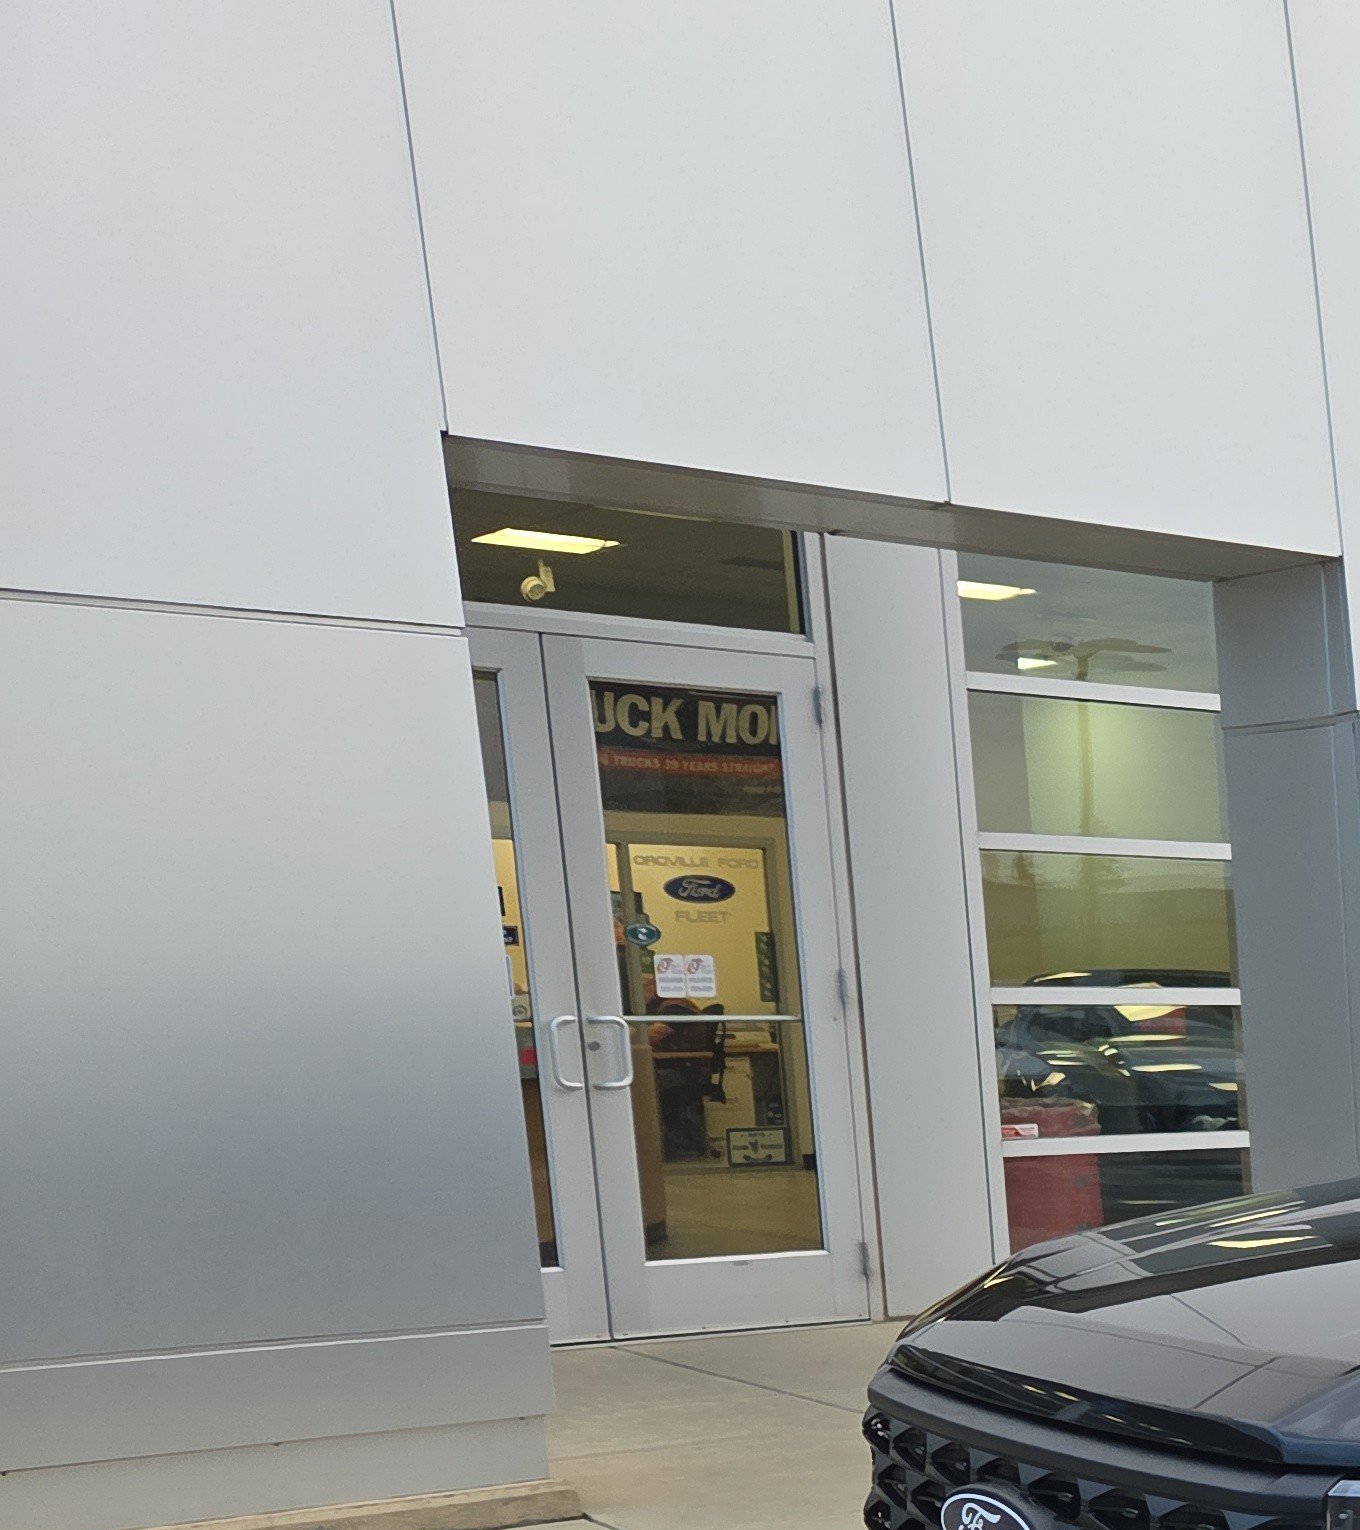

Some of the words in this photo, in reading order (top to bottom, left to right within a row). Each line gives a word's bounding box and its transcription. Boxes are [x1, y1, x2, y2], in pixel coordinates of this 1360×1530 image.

[633, 855, 709, 867] OROVILLE
[718, 858, 759, 869] FORD
[678, 878, 724, 899] Ford
[674, 910, 731, 924] FLEET
